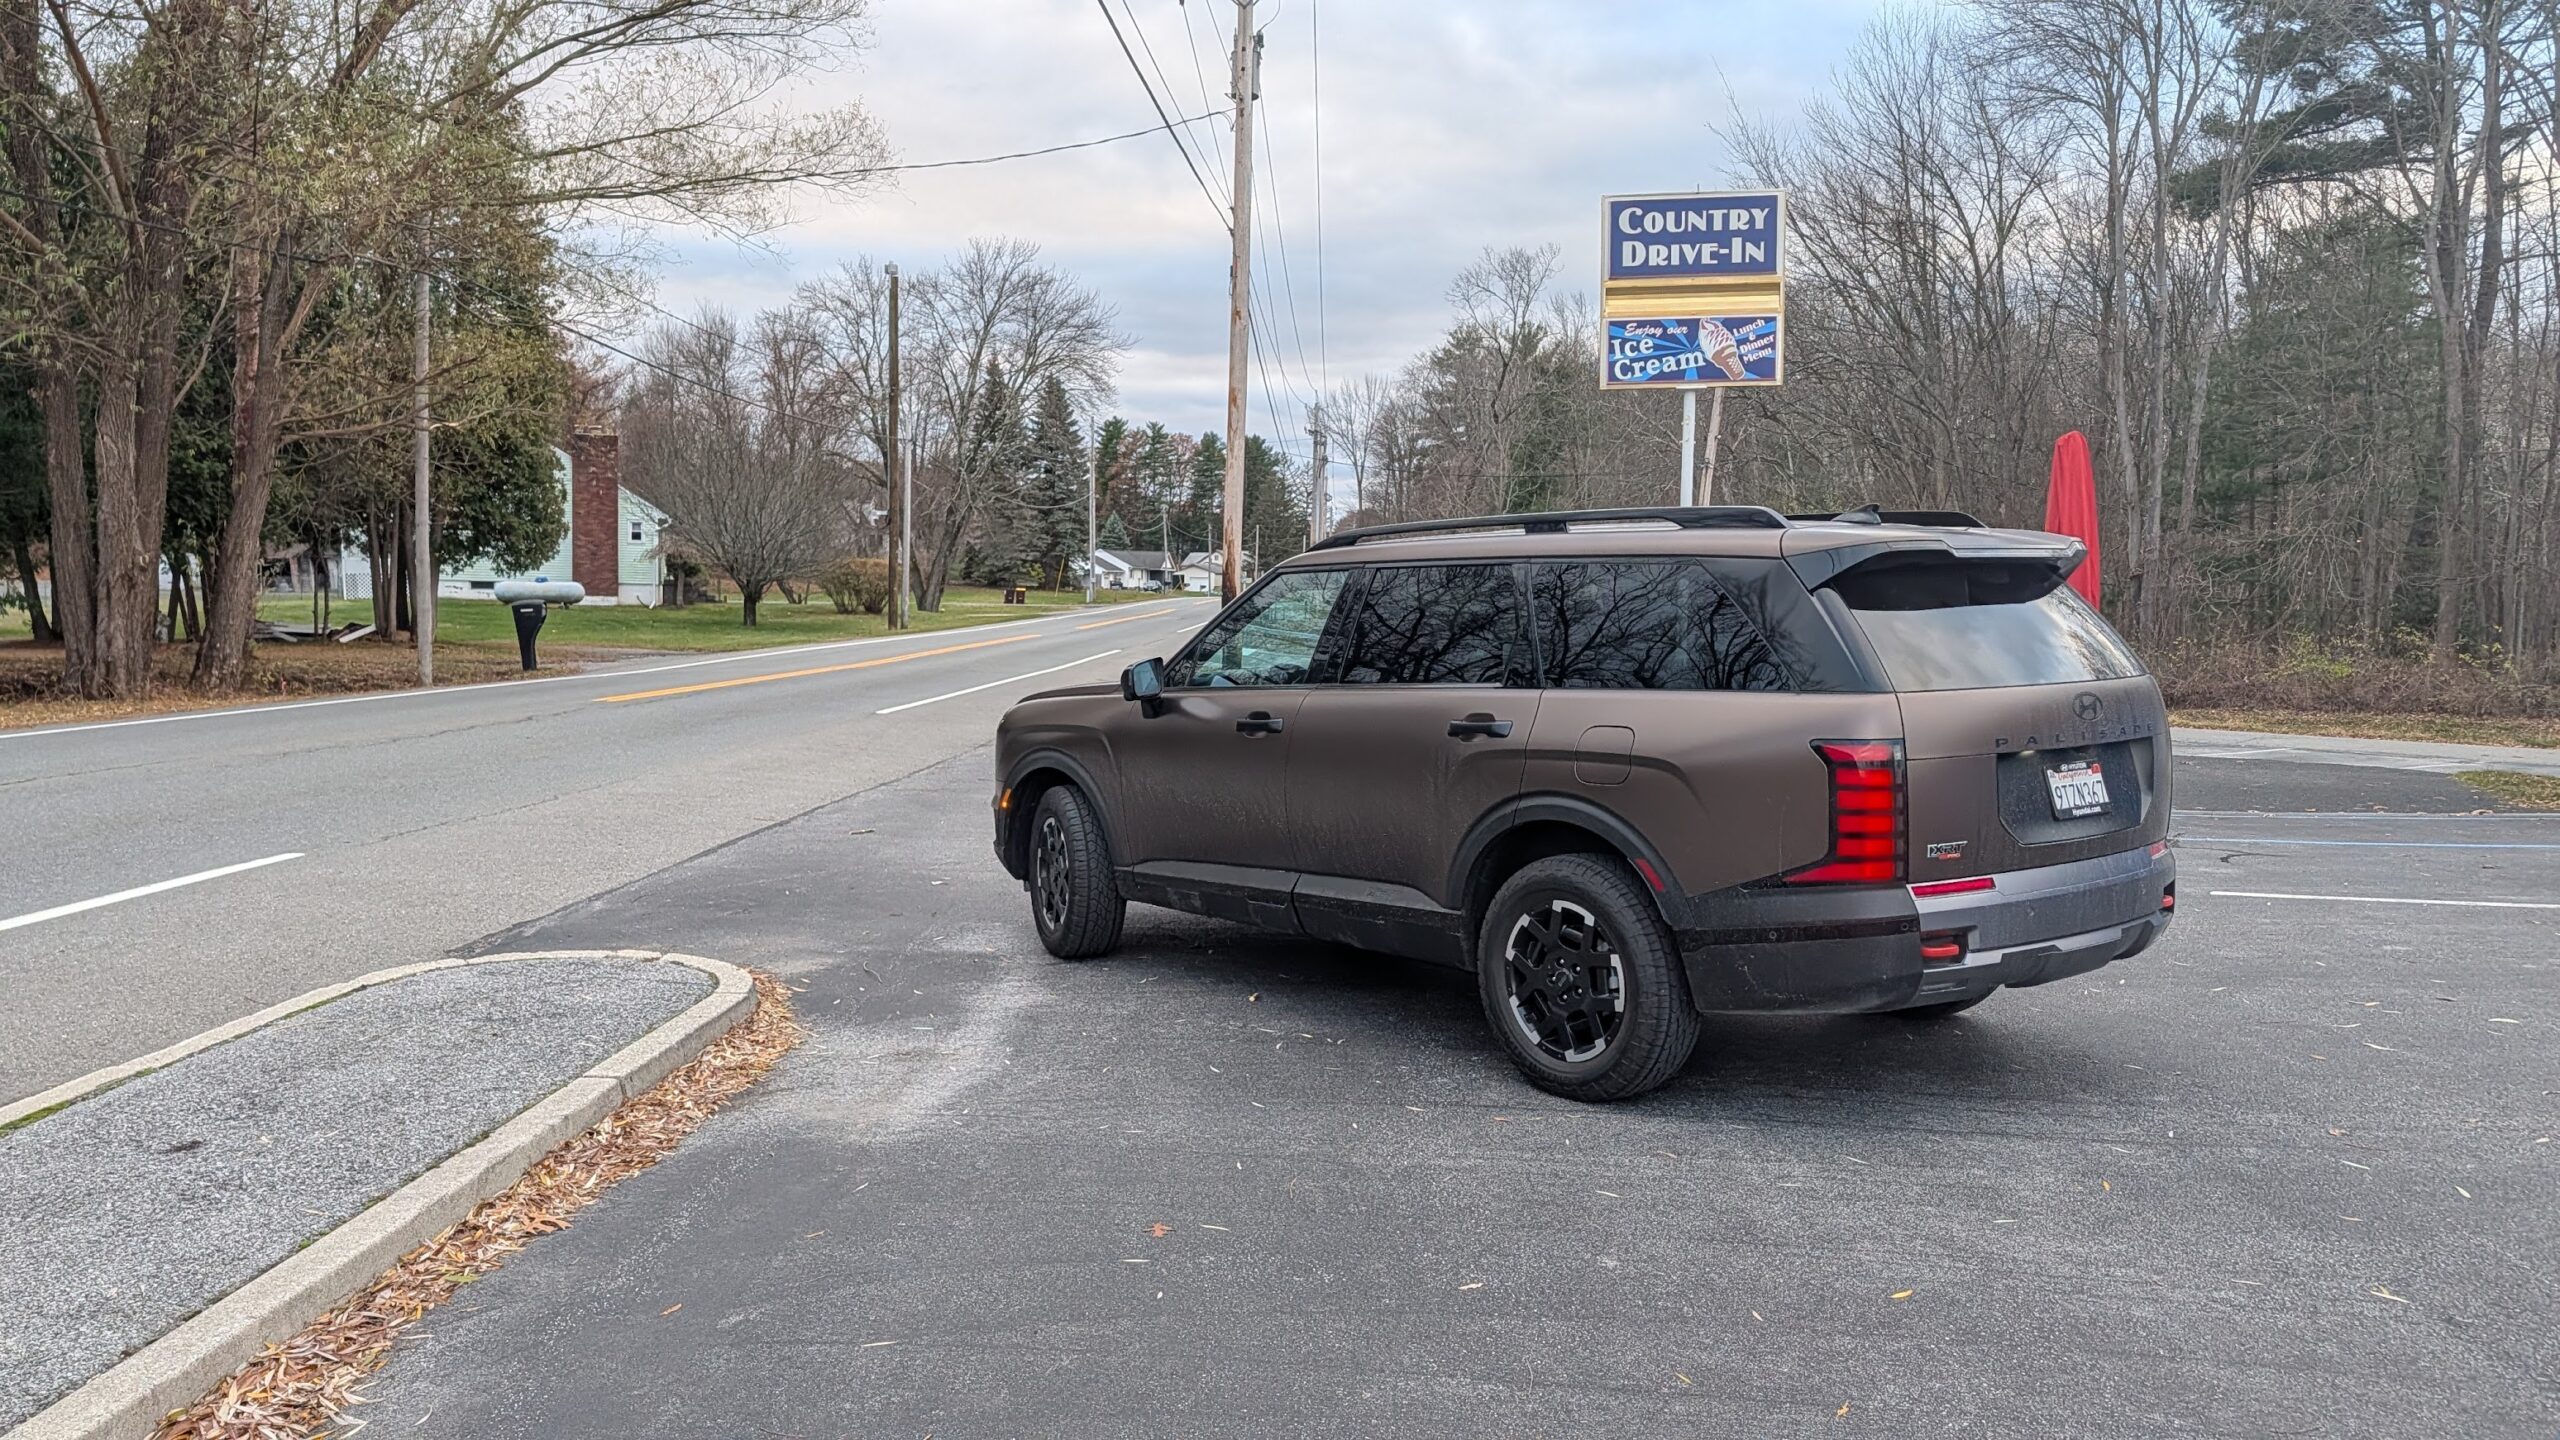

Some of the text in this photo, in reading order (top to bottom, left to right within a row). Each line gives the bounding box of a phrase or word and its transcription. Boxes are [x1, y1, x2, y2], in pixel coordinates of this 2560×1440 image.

[1618, 207, 1771, 235] COUNTRY
[1622, 237, 1765, 267] DRIVE-IN
[1624, 322, 1689, 337] Enjoy our
[1733, 318, 1766, 337] Lunch
[1749, 332, 1756, 340] &
[1611, 337, 1654, 359] Ice
[1739, 334, 1775, 354] Dinner
[1614, 350, 1706, 380] Cream
[1742, 347, 1773, 364] Menu
[1995, 725, 2152, 748] PALISADE
[2054, 780, 2106, 810] 9TZN367
